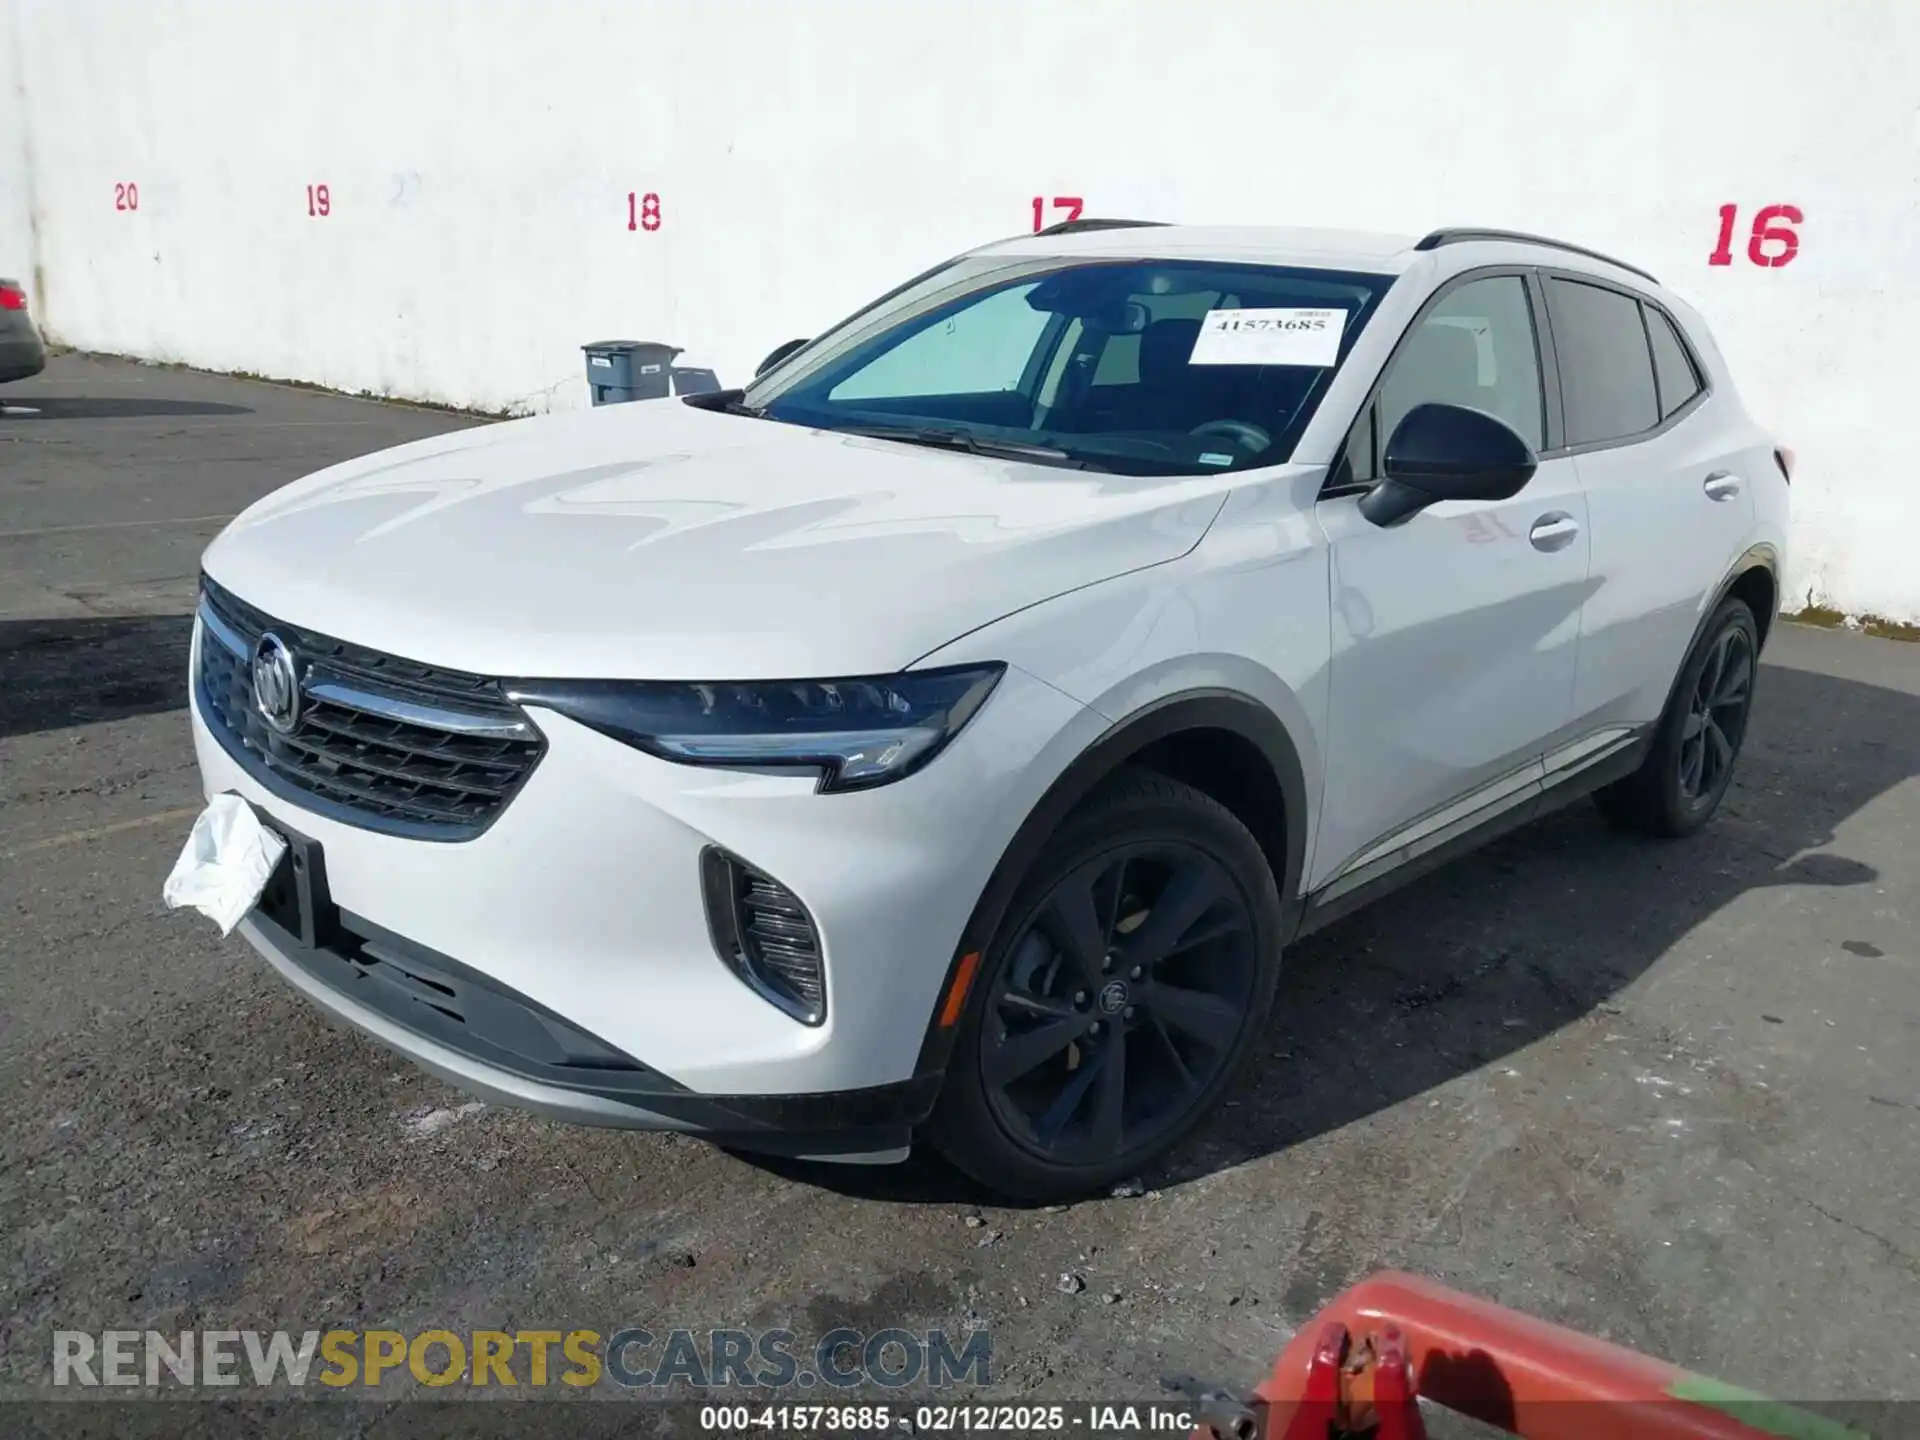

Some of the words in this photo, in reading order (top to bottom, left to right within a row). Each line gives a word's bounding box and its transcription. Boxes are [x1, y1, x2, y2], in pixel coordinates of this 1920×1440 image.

[115, 182, 138, 210] 20
[307, 184, 331, 216] 19
[628, 192, 661, 231] 18
[1032, 196, 1084, 234] 17
[1708, 203, 1805, 268] 16
[1215, 319, 1327, 331] 41573685
